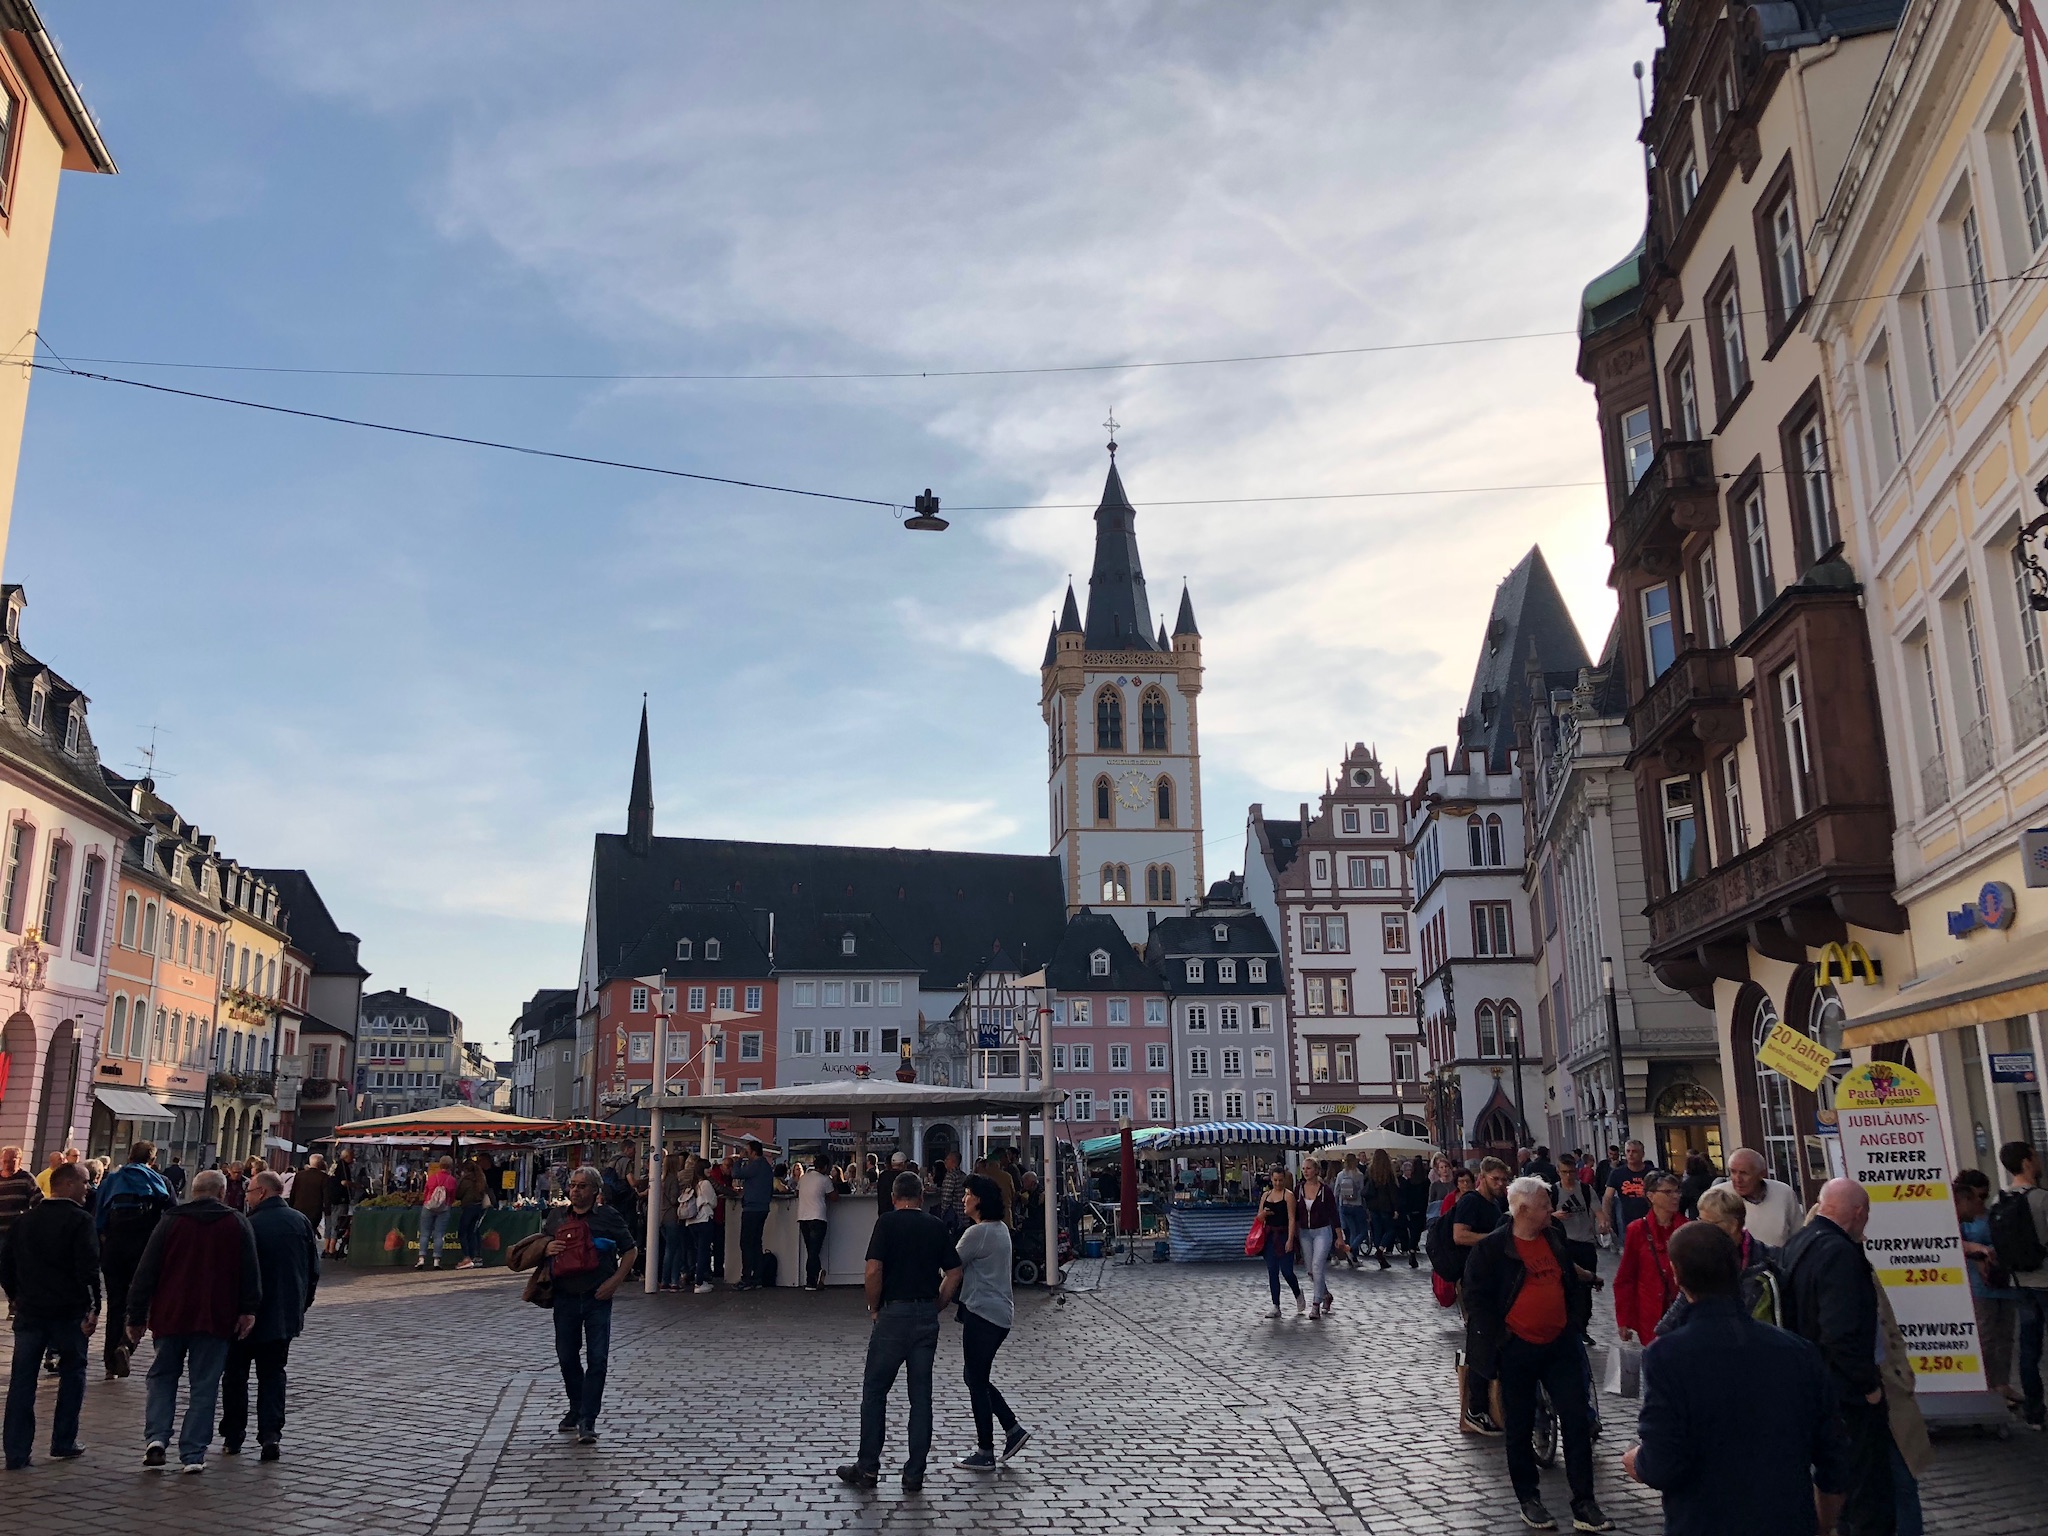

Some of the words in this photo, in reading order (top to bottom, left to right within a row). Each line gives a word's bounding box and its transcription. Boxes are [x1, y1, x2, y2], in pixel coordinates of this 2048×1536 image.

[980, 1025, 998, 1035] WC
[1771, 1025, 1792, 1045] 20
[1791, 1038, 1830, 1068] Jahre
[1317, 1104, 1355, 1114] SUBWAY
[1848, 1111, 1930, 1128] JUBILÄUMS-
[1860, 1131, 1924, 1146] ANGEBOT
[1867, 1150, 1926, 1164] TRIERER
[1858, 1168, 1942, 1182] BRATWURST
[1865, 1237, 1959, 1251] CURRYWURST
[1890, 1254, 1940, 1265] (NORMAL)
[1898, 1322, 1975, 1337] RRYWURST
